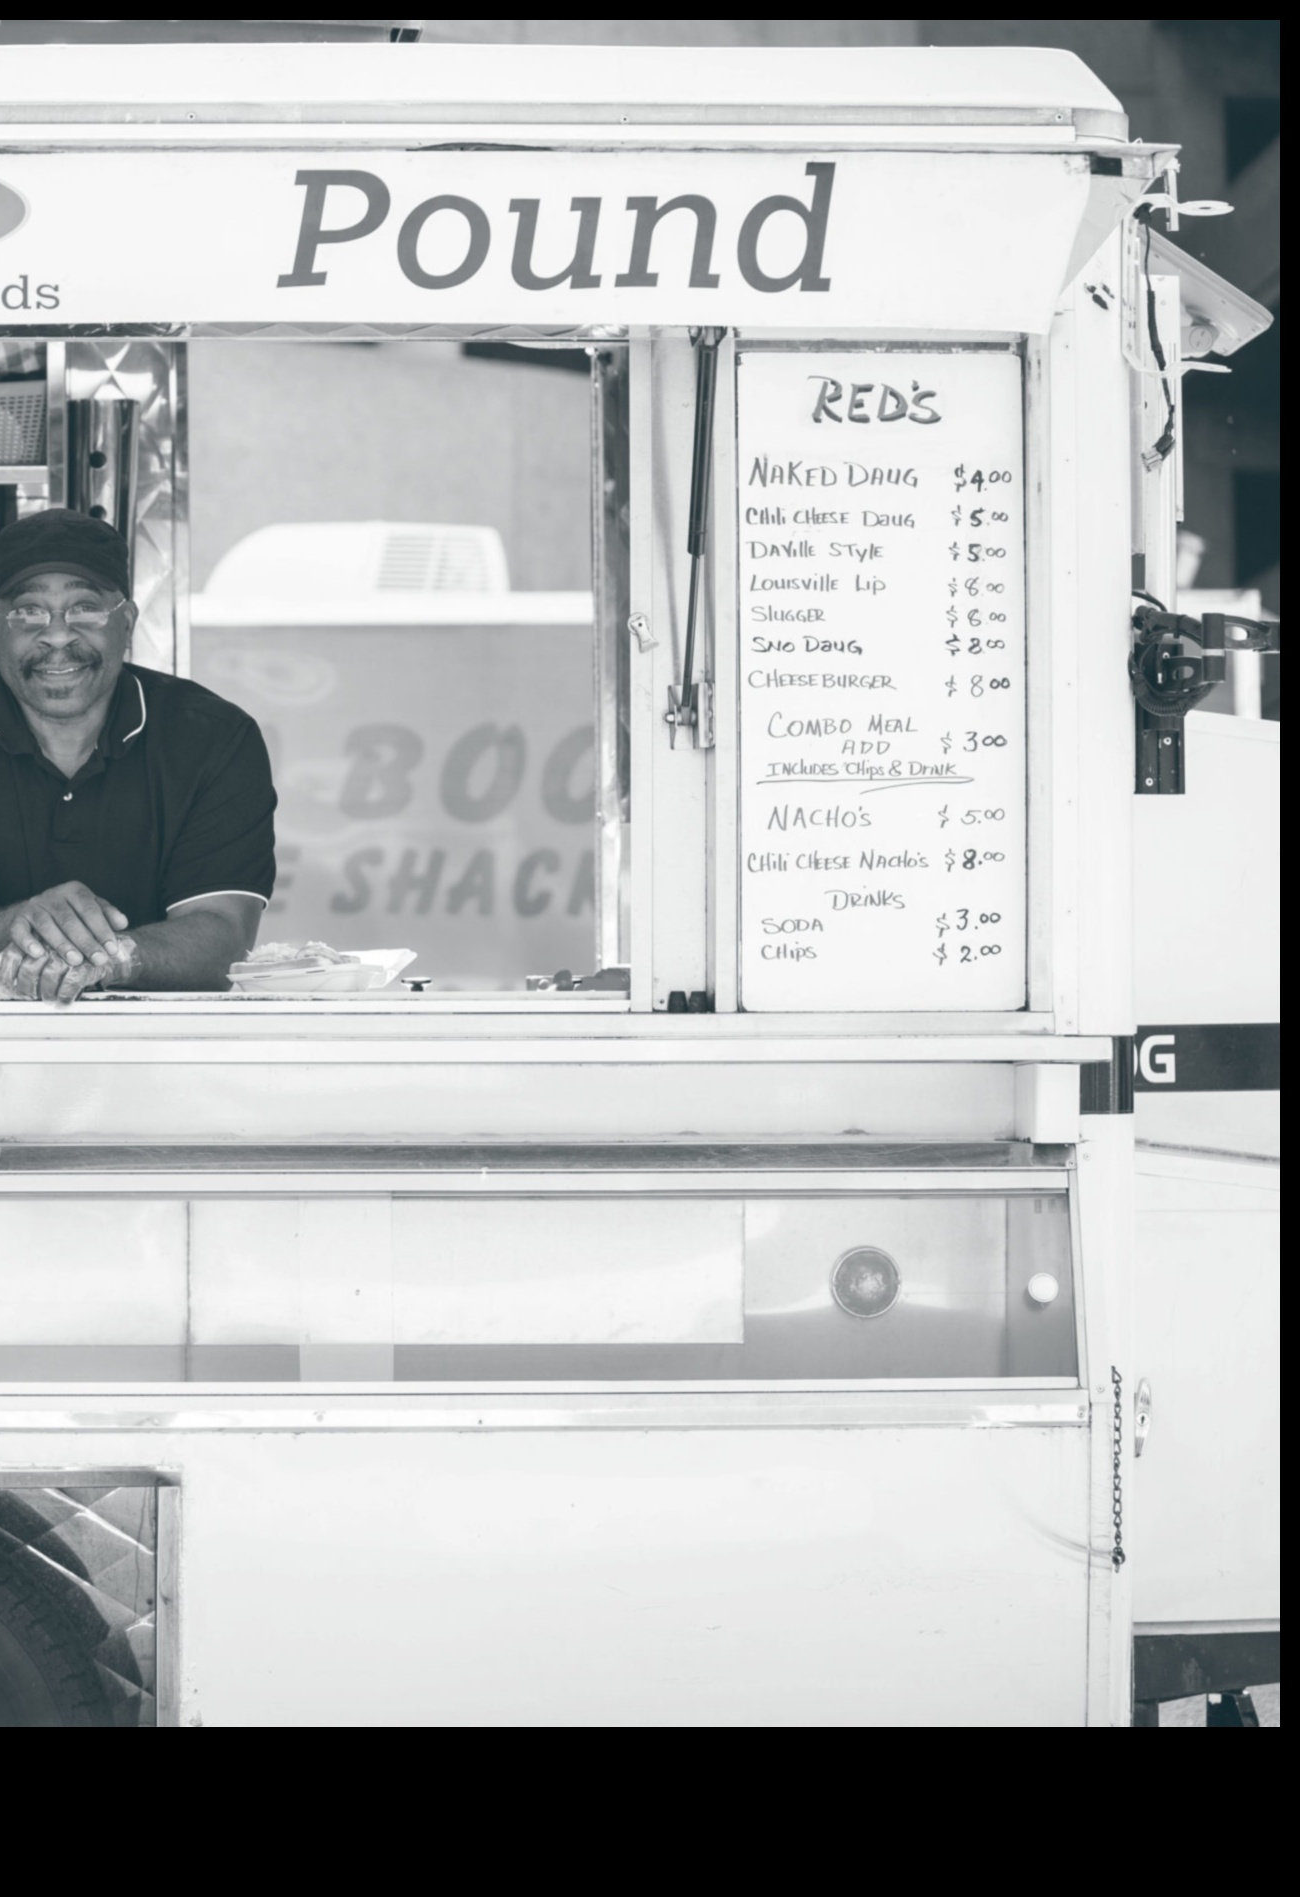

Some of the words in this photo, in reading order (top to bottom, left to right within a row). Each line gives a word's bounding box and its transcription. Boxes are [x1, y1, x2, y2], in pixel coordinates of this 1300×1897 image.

[276, 162, 837, 293] Pound
[748, 454, 837, 487] NAKED
[767, 711, 852, 738] COMBO
[867, 713, 919, 736] MEAL
[841, 739, 891, 755] ADD
[888, 759, 902, 777] &
[761, 917, 824, 934] SODA
[1133, 1034, 1176, 1084] G
